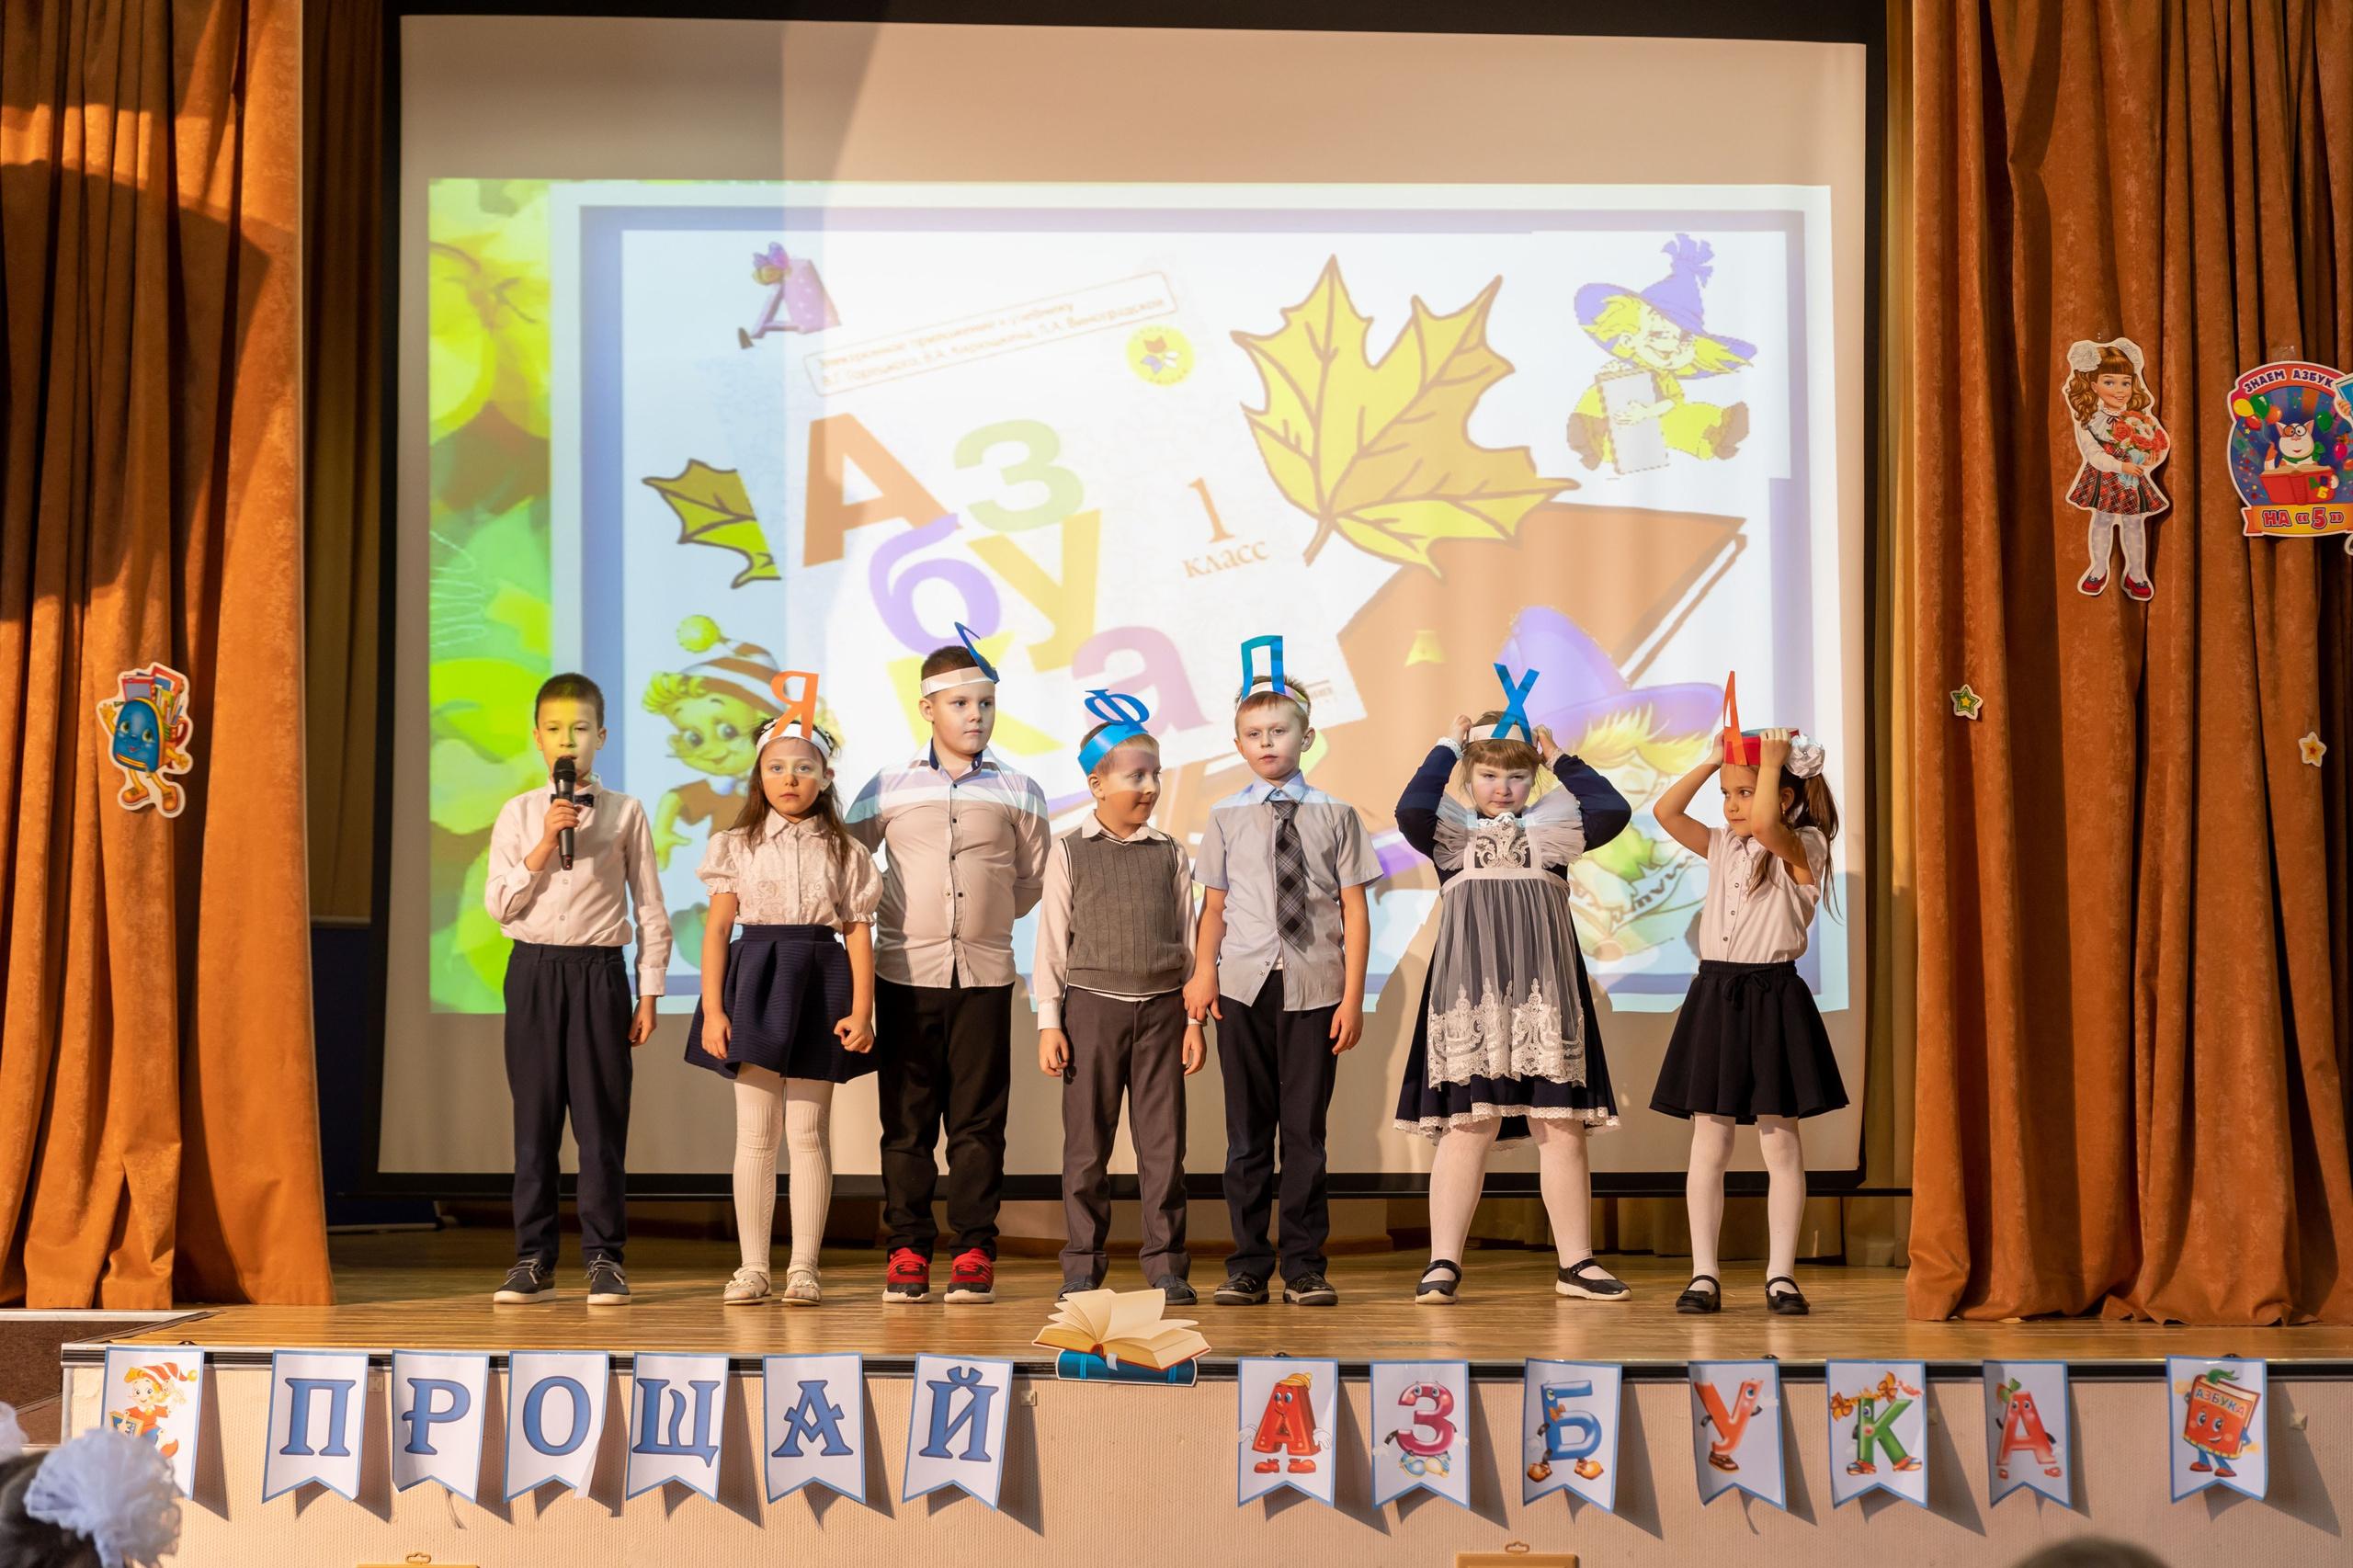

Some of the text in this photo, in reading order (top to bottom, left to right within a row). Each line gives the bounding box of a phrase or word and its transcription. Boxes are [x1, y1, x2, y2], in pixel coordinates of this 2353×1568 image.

[2244, 369, 2336, 393] ЗНАЕМ АЗБУК
[1188, 477, 1235, 544] 1
[2262, 509, 2292, 528] НА
[1183, 540, 1269, 579] класс
[768, 670, 819, 740] Я
[1084, 688, 1150, 734] Ф
[1491, 662, 1540, 744] Х
[2195, 1388, 2245, 1415] АЗБУКА
